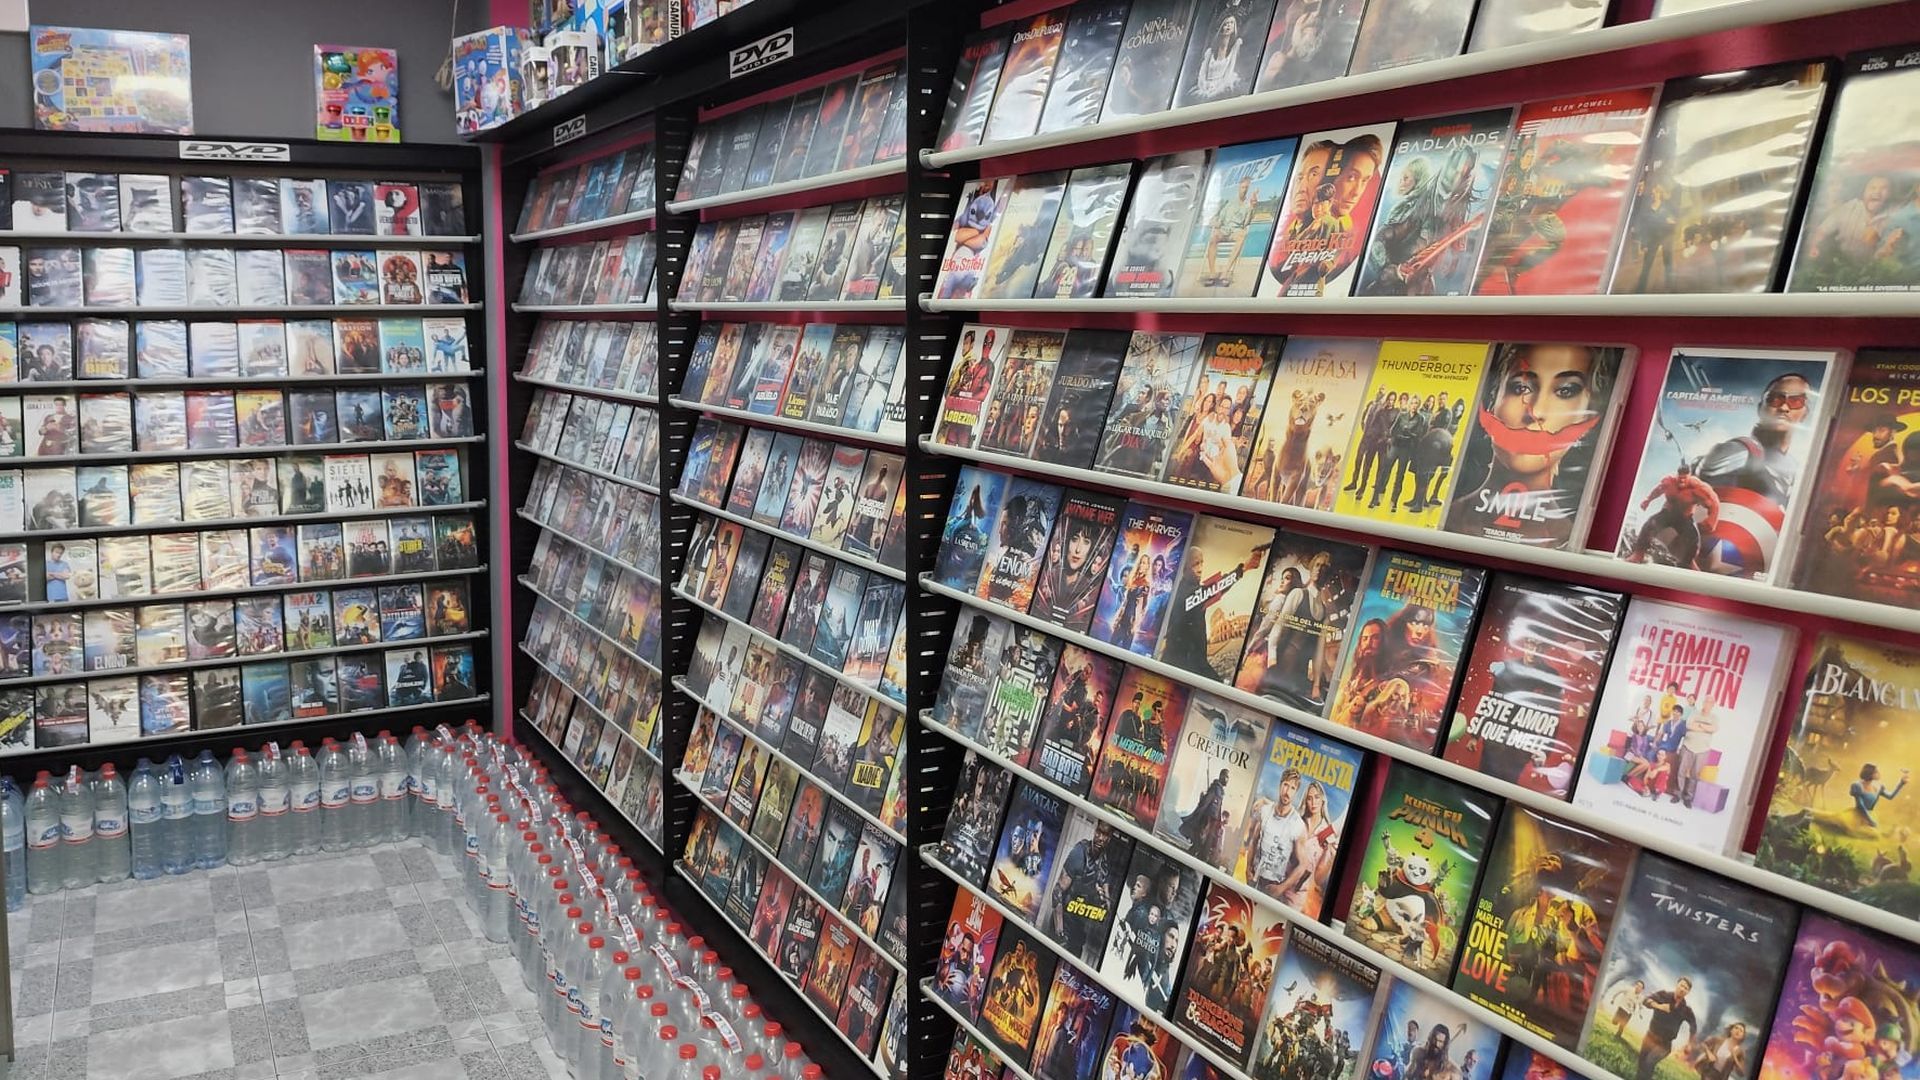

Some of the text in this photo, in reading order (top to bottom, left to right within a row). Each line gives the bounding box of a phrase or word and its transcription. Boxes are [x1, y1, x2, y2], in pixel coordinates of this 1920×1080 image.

[670, 0, 680, 40] SAMUR
[733, 33, 793, 67] DVD
[589, 56, 597, 78] CARL
[742, 54, 778, 71] VIDEO
[1577, 100, 1613, 110] POWELL
[556, 119, 585, 137] DVD
[186, 143, 287, 154] DVD
[1398, 131, 1500, 153] BADLANDS
[1281, 249, 1336, 272] LEGENDS
[1285, 357, 1357, 379] MUFASA
[1667, 391, 1706, 401] CAPITÁN
[1850, 387, 1890, 404] LOS
[329, 464, 365, 476] SIETE
[1474, 488, 1551, 523] SMILE
[1128, 517, 1182, 538] THE MARVELS
[1185, 571, 1238, 612] EQUALIZER
[1383, 568, 1460, 606] FURIOSA
[1300, 616, 1312, 627] DEL
[1654, 628, 1751, 676] FAMILIA
[1628, 645, 1743, 711] BENETON
[1475, 697, 1559, 736] ESTE AMOR
[1480, 723, 1508, 744] QUE
[1186, 731, 1250, 769] CREATOR
[1040, 747, 1059, 769] BAD
[1057, 753, 1083, 780] BOYS
[1270, 736, 1354, 792] ESPECIALISTA
[1021, 785, 1060, 816] AVATAR
[1404, 793, 1463, 824] KUNG FU
[1389, 805, 1470, 848] PANDA
[1414, 829, 1435, 850] 4
[1066, 900, 1108, 922] SYSTEM
[1478, 898, 1492, 913] BOB
[1476, 908, 1505, 929] MARLEY
[1650, 892, 1761, 943] TWISTERS
[1136, 937, 1156, 954] DUELO
[1469, 921, 1509, 958] ONE
[1461, 949, 1514, 992] LOVE
